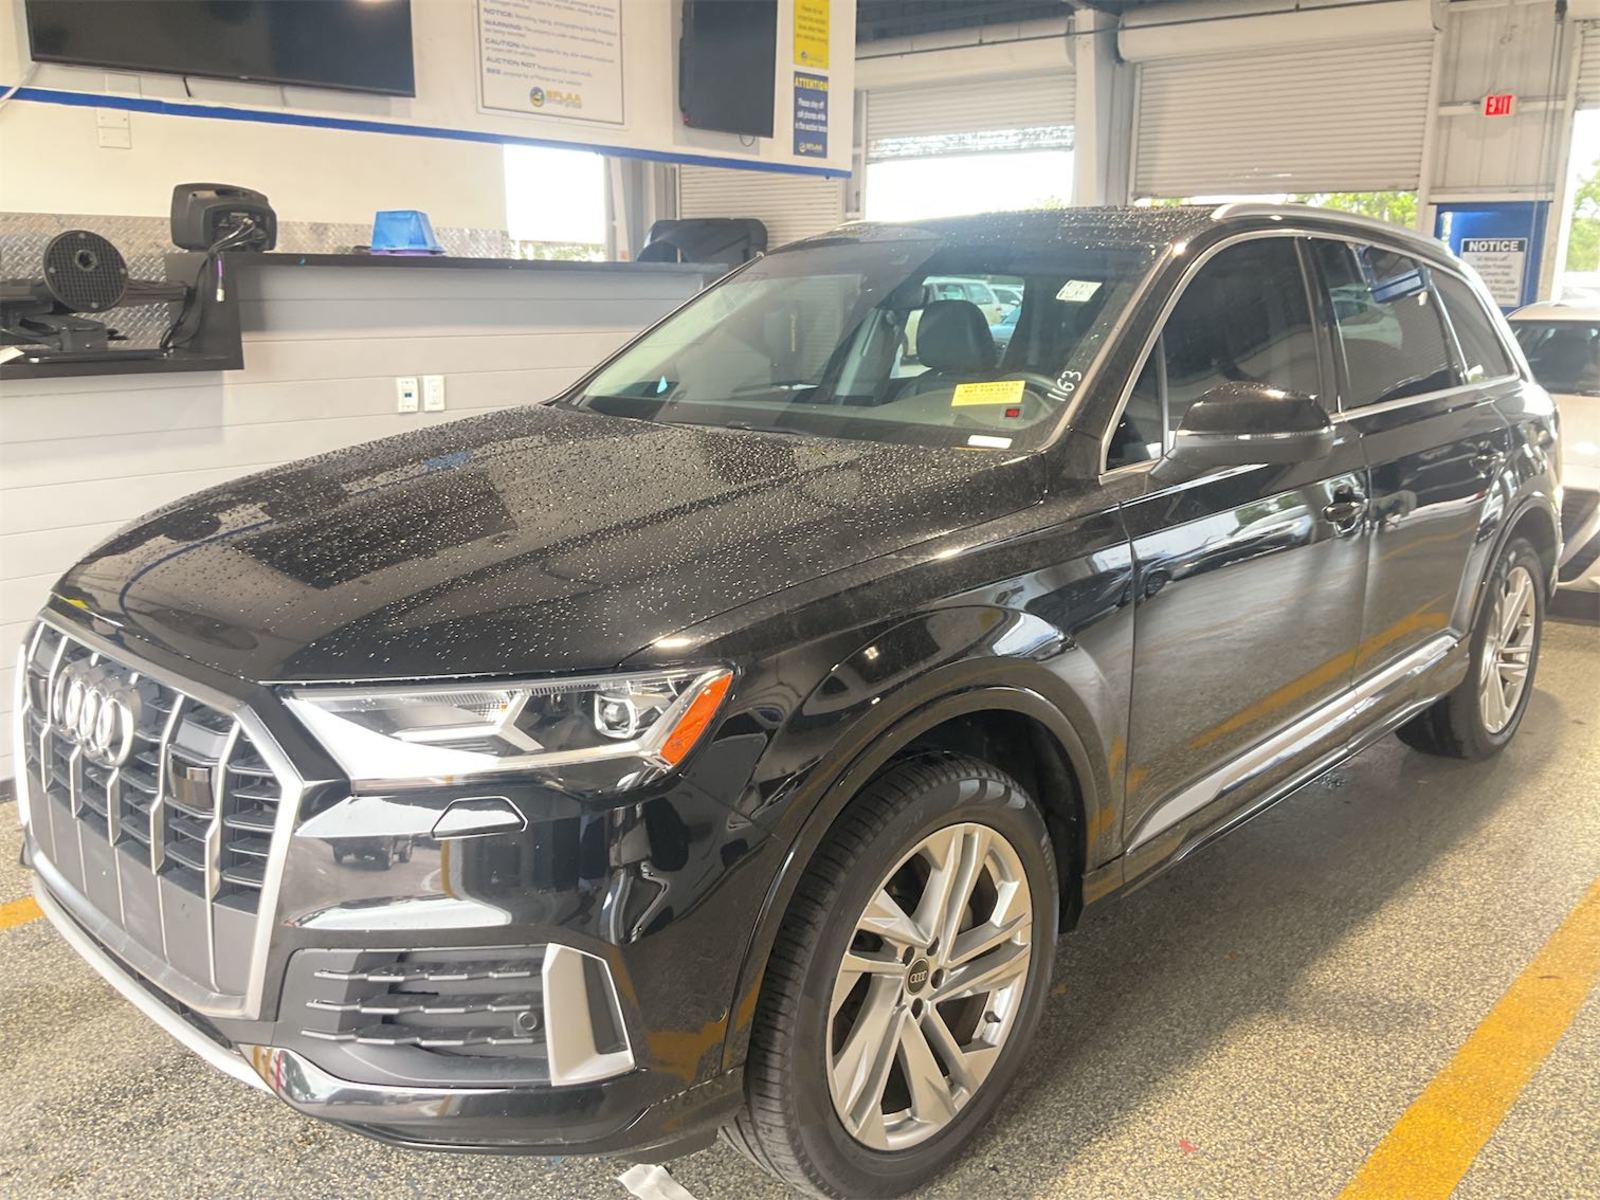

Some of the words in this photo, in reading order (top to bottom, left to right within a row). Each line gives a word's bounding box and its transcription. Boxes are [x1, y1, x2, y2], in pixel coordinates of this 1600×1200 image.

[1486, 95, 1512, 115] EXIT
[1468, 240, 1519, 252] NOTICE
[1047, 370, 1082, 402] 1163
